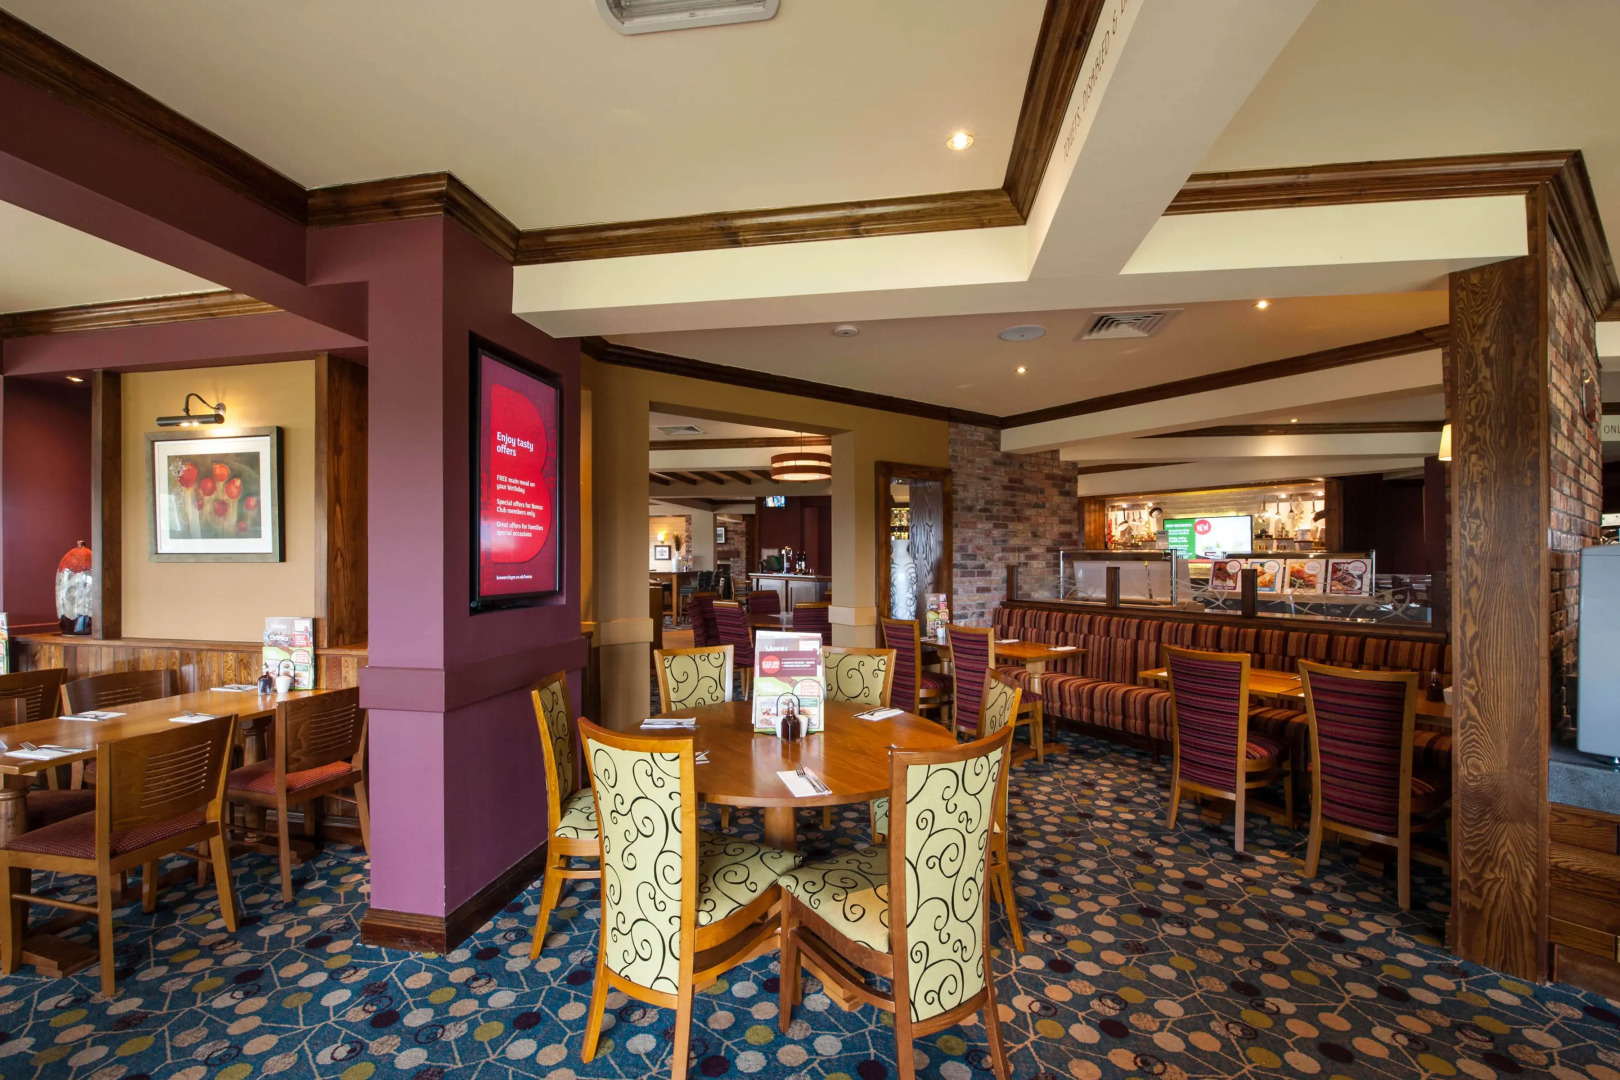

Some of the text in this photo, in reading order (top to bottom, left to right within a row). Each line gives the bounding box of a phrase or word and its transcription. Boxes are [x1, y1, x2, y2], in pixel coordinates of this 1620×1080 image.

[496, 431, 534, 452] Enjoy tasty
[496, 444, 517, 457] offers
[496, 474, 508, 482] FREE
[507, 484, 526, 494] birthday
[496, 498, 513, 507] Special
[512, 500, 525, 508] offers
[507, 508, 527, 516] members
[1196, 523, 1209, 532] NEW
[269, 633, 289, 642] Drinks
